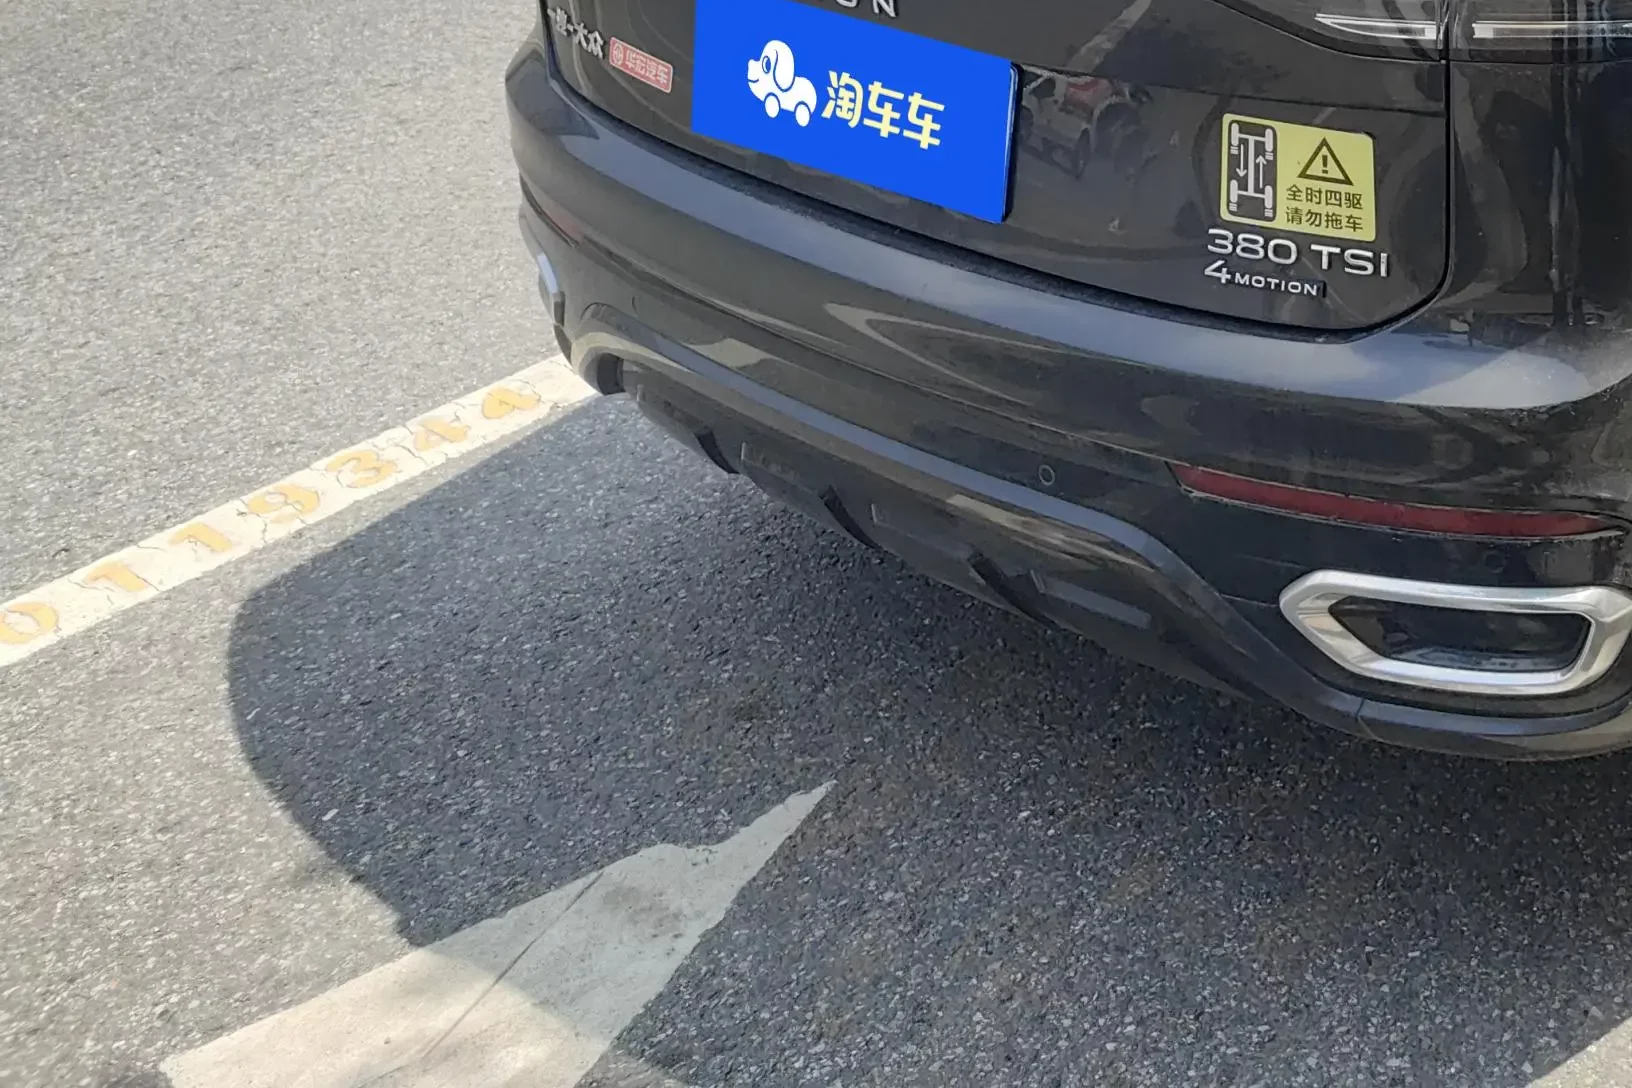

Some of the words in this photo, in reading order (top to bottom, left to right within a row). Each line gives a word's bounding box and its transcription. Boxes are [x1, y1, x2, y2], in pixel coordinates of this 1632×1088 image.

[1285, 183, 1364, 211] 全时四驱
[1285, 206, 1364, 233] 请勿拖车
[1206, 227, 1299, 266] 380
[1310, 243, 1389, 278] TSI
[1203, 259, 1319, 298] 4MOTION
